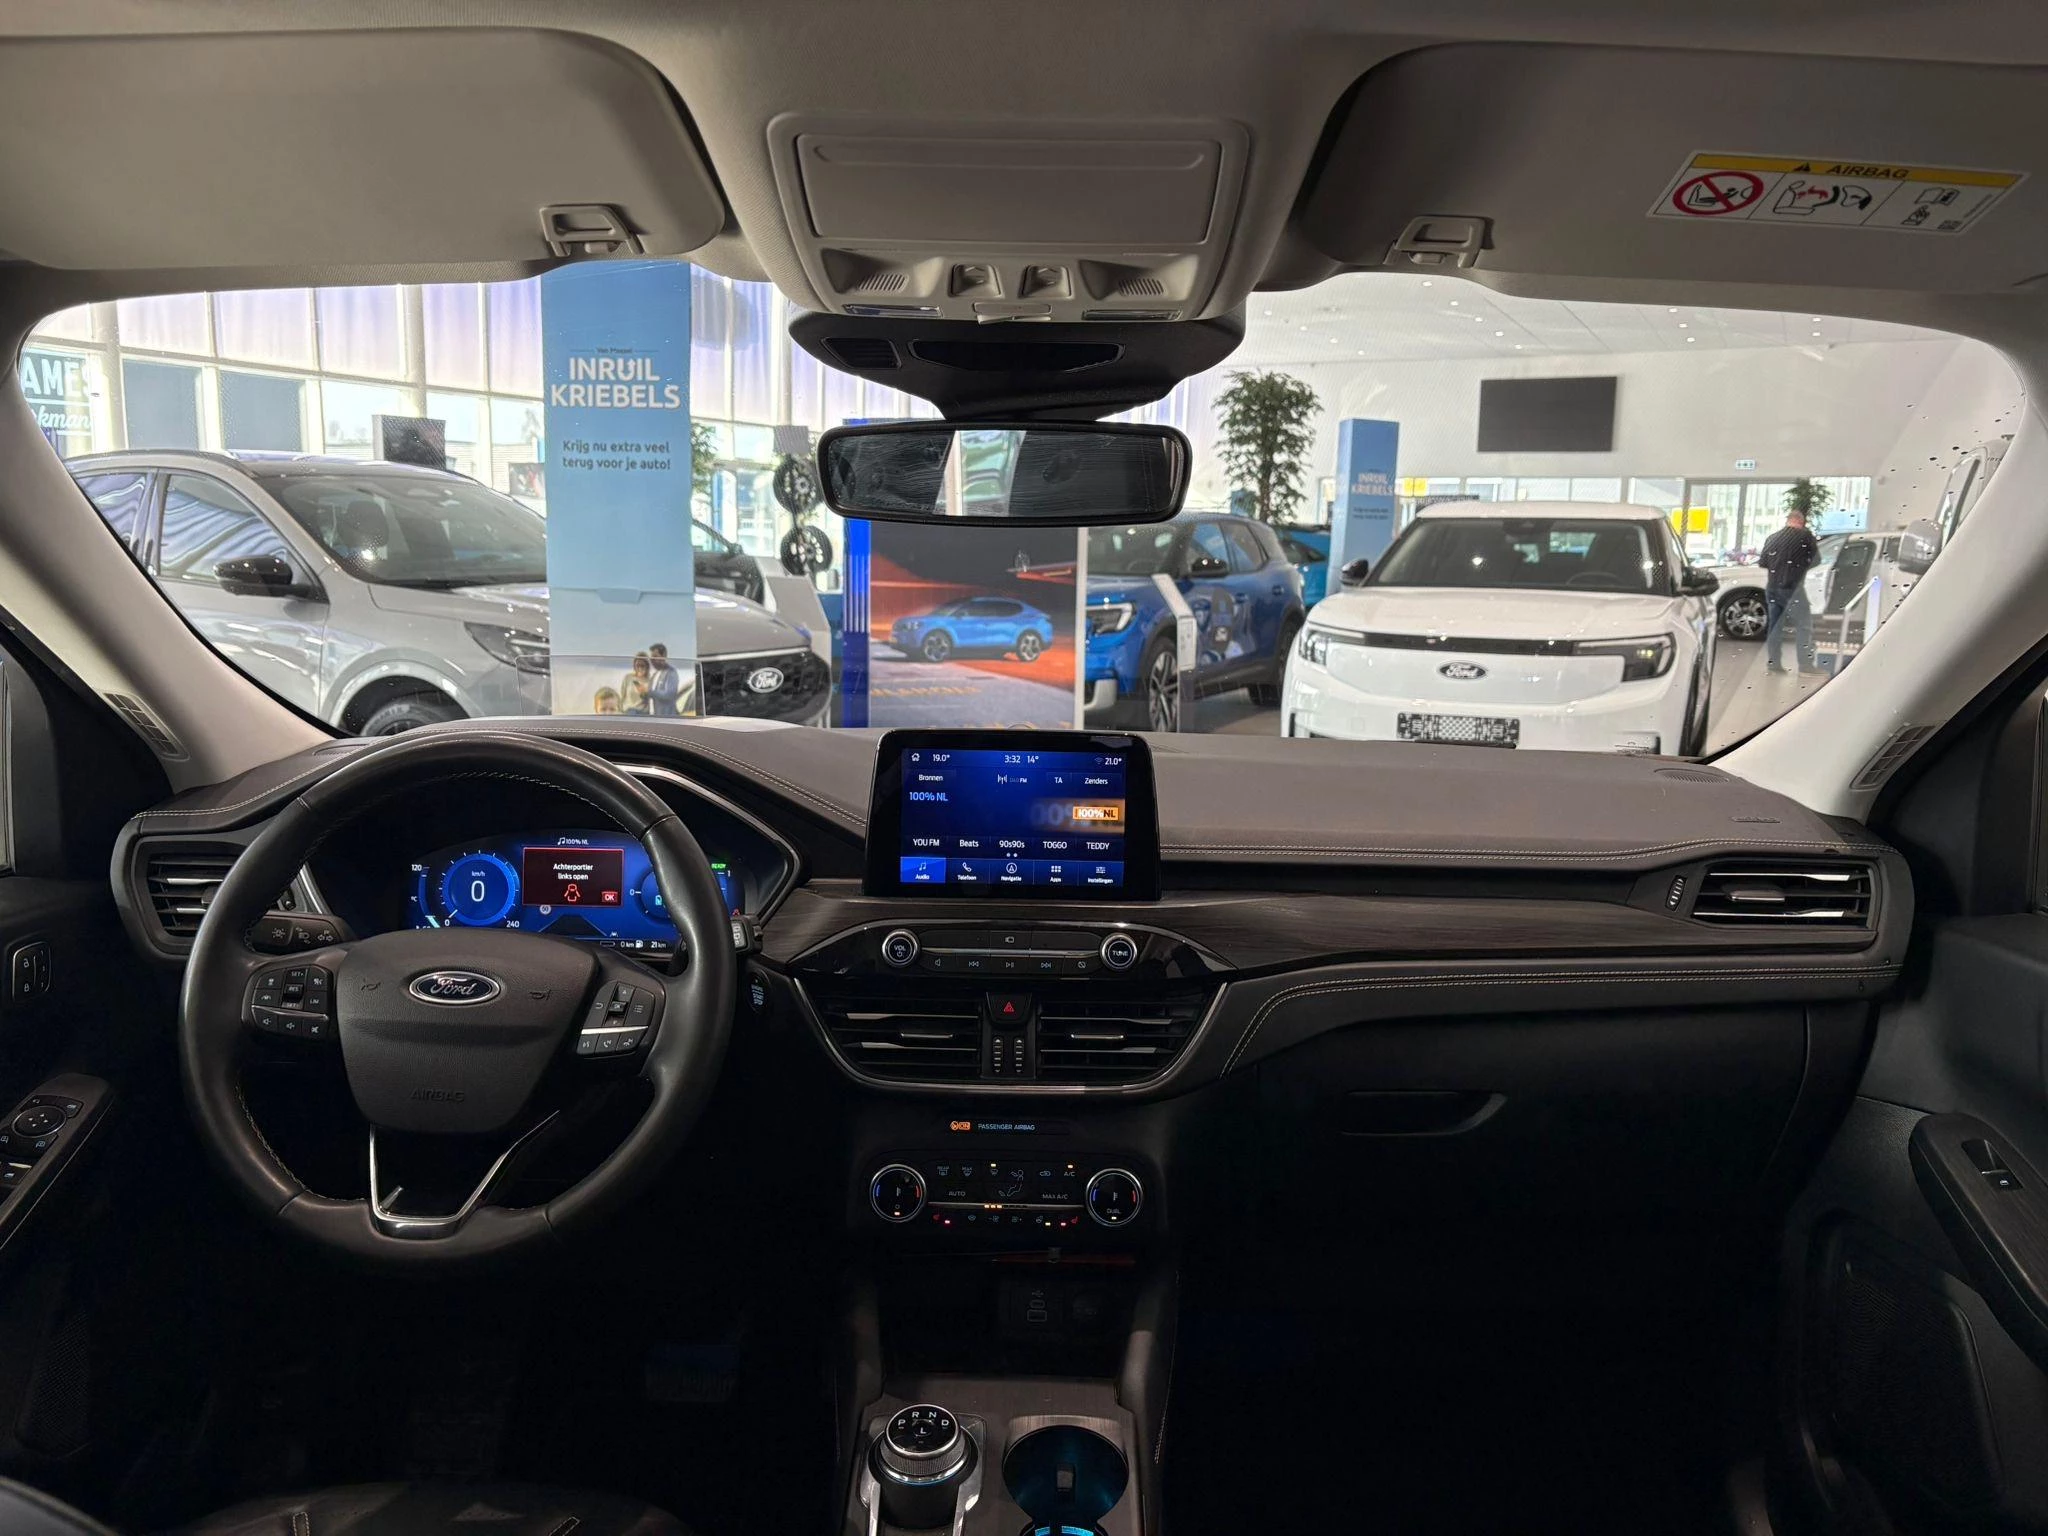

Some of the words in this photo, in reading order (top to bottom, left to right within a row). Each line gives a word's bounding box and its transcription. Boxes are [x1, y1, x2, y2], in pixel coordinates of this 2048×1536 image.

[1826, 164, 1911, 180] AIRBAG
[569, 357, 660, 381] INRUIL
[551, 384, 681, 409] KRIEBELS
[563, 440, 590, 454] Krijg
[593, 443, 607, 452] nu
[610, 442, 642, 453] extra
[644, 442, 670, 453] veel
[563, 457, 594, 470] terug
[597, 461, 623, 469] voor
[625, 459, 638, 471] je
[640, 459, 671, 470] auto!
[755, 671, 778, 688] Ford
[932, 754, 951, 762] 19.0°
[1004, 755, 1021, 764] 3:32
[1027, 756, 1039, 764] 14°
[1104, 758, 1122, 766] 21.0°
[918, 774, 944, 782] Bronnen
[909, 792, 935, 801] 100%
[936, 793, 948, 802] NL
[929, 839, 940, 847] FM
[1043, 841, 1067, 849] TOGGO
[1086, 842, 1110, 850] TEDDY
[470, 880, 485, 902] 0
[604, 893, 615, 901] OK
[444, 919, 451, 927] 0
[506, 920, 520, 929] 240
[893, 944, 906, 952] VOL
[1112, 949, 1129, 957] TUNE
[430, 975, 478, 996] Ford
